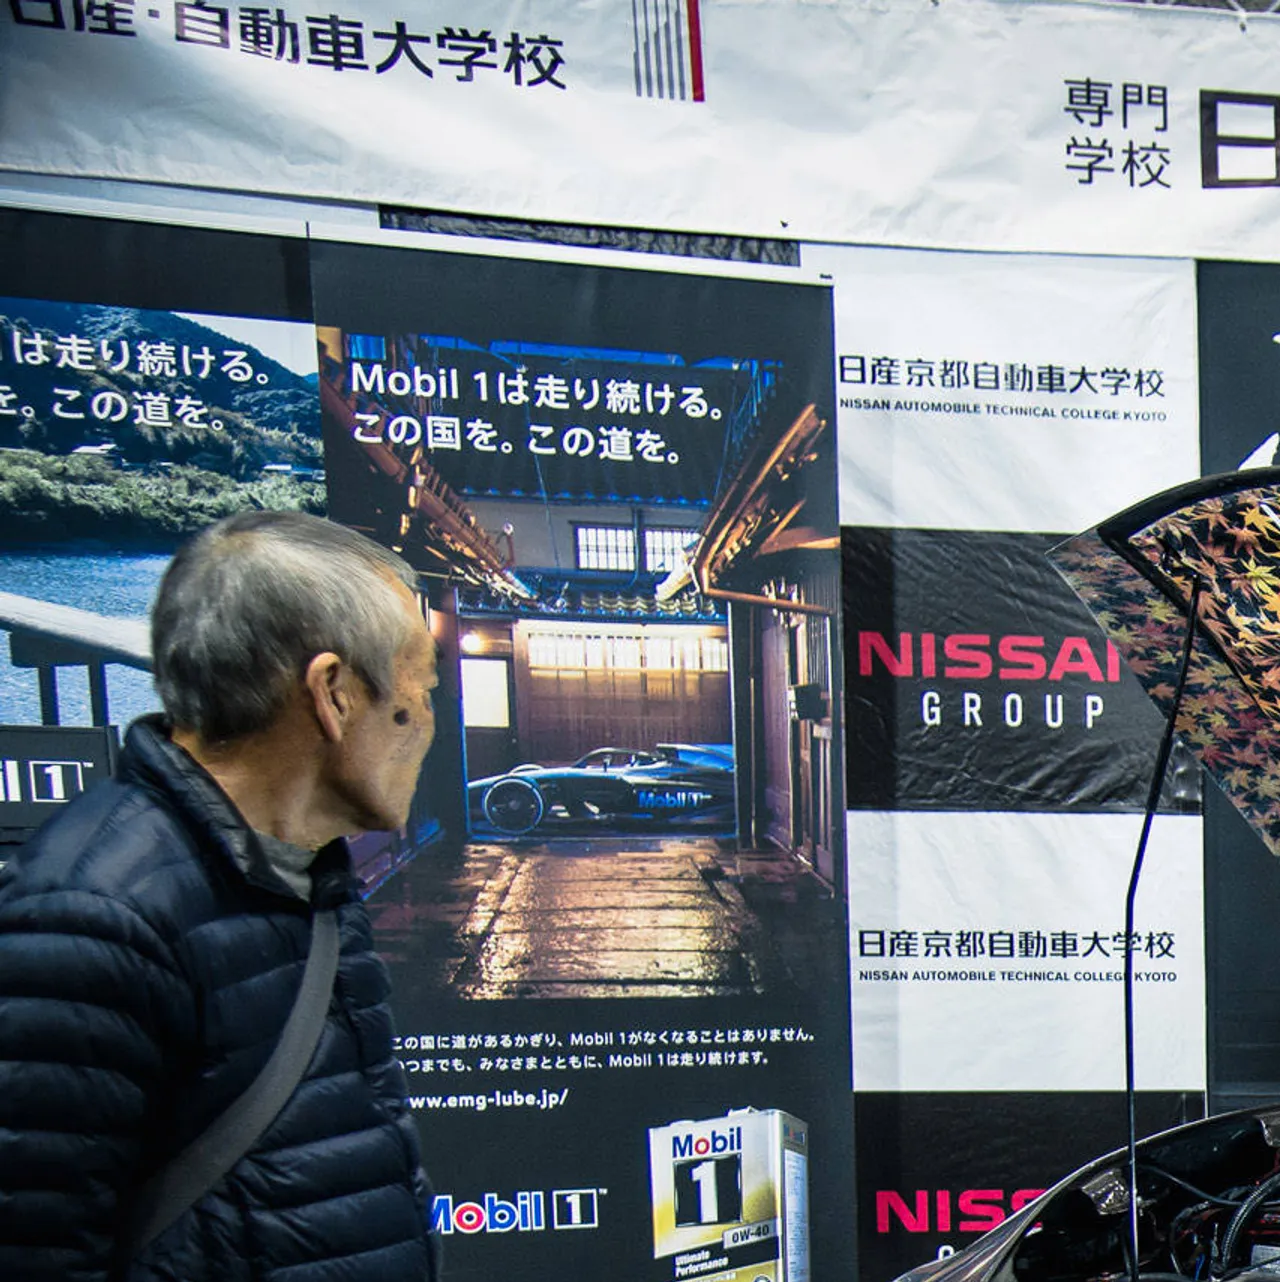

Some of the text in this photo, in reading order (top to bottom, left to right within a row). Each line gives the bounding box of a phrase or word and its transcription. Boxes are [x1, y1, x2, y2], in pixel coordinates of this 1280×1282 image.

[1064, 77, 1169, 133] 専門
[1064, 137, 1171, 190] 学校
[0, 331, 269, 385] は走り続ける。
[351, 362, 723, 421] Mobil 1は走り続ける。
[839, 354, 1165, 398] 日産京都自動車大学校
[840, 398, 1167, 422] NISSAN AUTOMOBILE TECHNICAL COLLEGE KYOTO
[352, 411, 680, 466] この国を。この道を。
[921, 691, 1104, 729] GROUP
[858, 929, 1177, 960] 日産京都自動車大学校
[859, 970, 1177, 982] NISSAN AUTOMOBILE TECHNICAL COLLEG KYOTO
[570, 1032, 614, 1047] Mobil
[609, 1054, 652, 1069] Mobil
[408, 1088, 569, 1111] ww.emg-lube.jp/
[672, 1126, 743, 1158] Mobil
[689, 1160, 719, 1224] 1
[565, 1193, 582, 1224] 1
[731, 1224, 770, 1244] 0W-40
